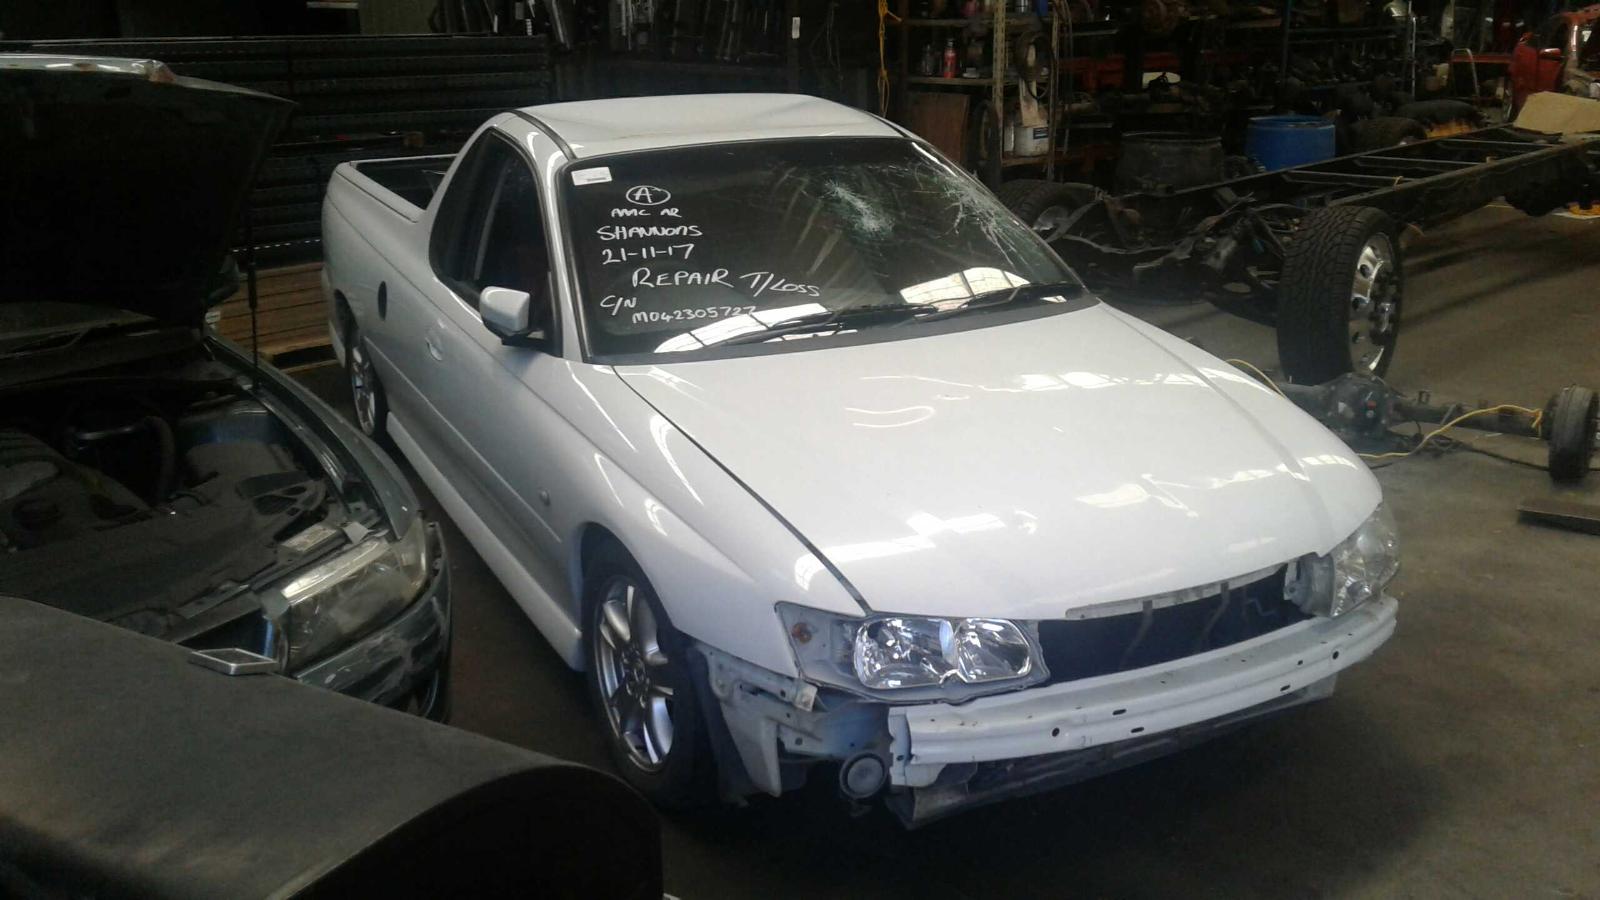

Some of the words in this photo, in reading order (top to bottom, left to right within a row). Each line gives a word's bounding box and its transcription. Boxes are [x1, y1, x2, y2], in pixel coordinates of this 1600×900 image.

[597, 225, 703, 240] SHANNONS
[602, 243, 694, 264] 21-11-17
[632, 268, 734, 288] REPAIR
[739, 272, 821, 297] T/LOSS
